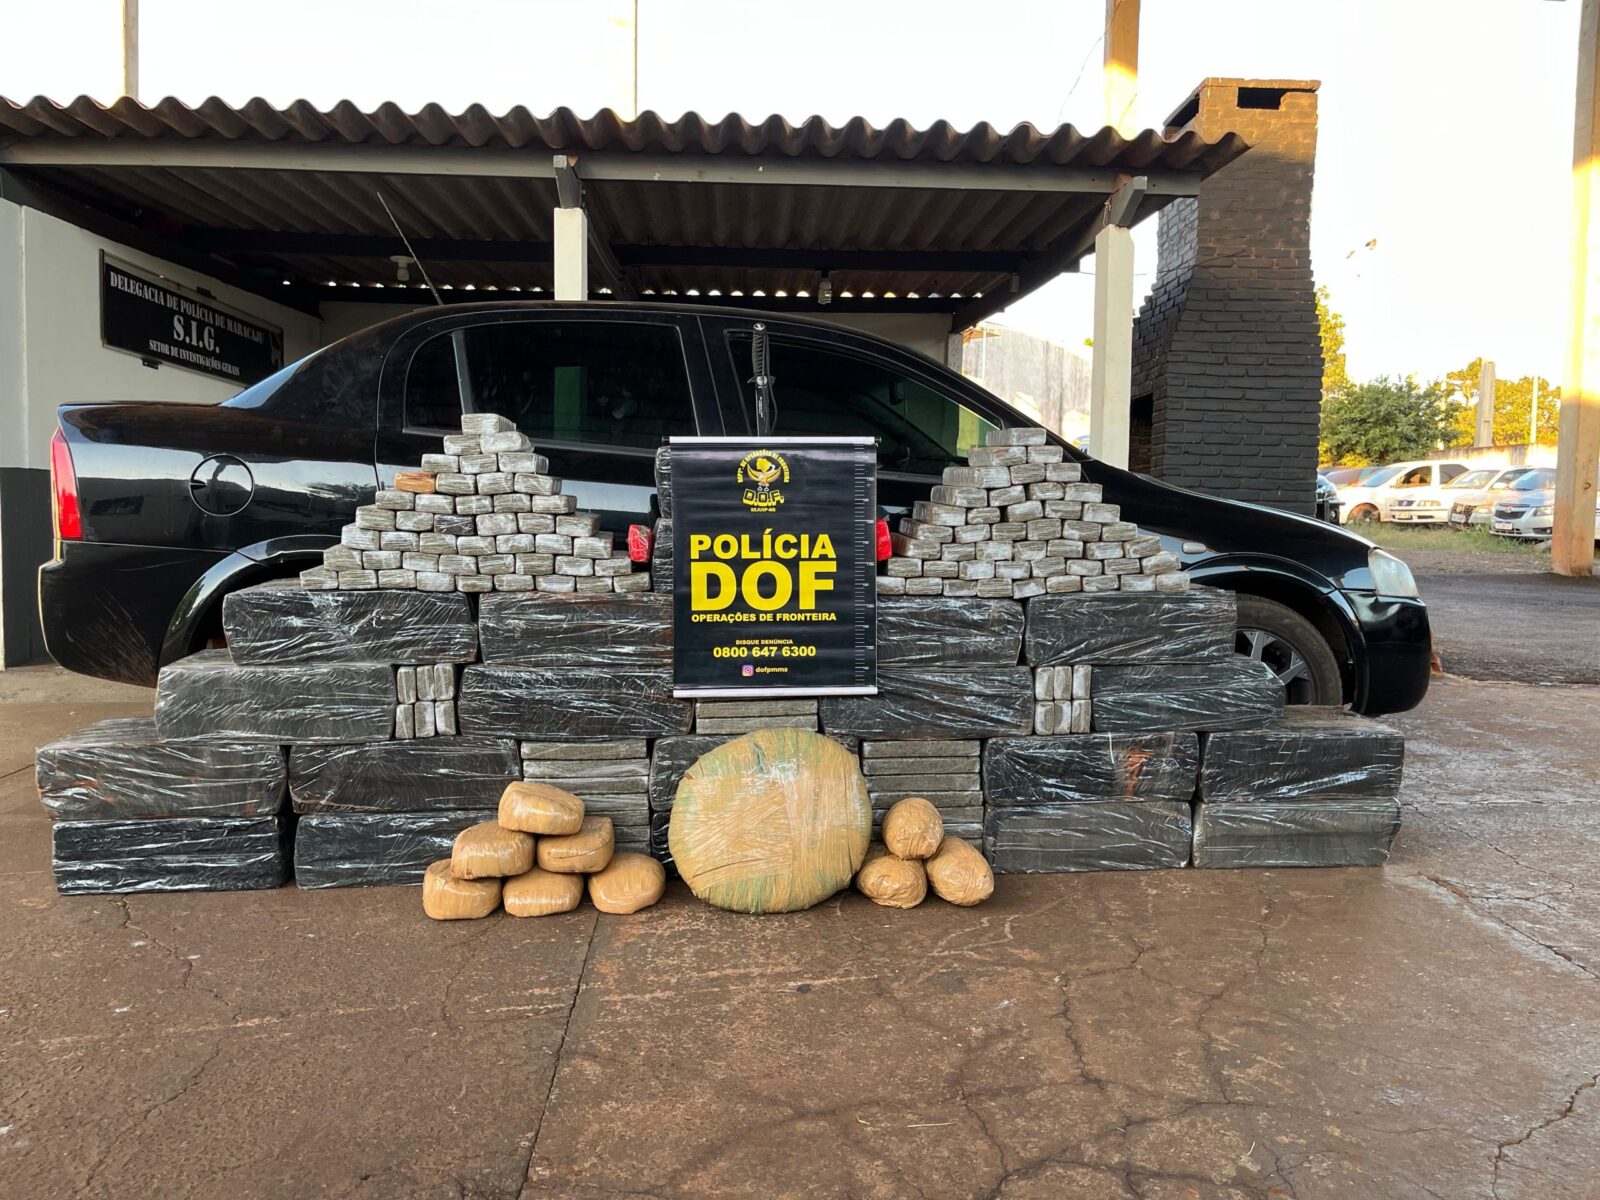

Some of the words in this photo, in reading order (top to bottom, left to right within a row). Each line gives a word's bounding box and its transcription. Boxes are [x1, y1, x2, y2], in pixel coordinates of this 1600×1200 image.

[110, 271, 165, 306] DELEGACIA
[166, 293, 179, 311] DE
[215, 313, 226, 329] DE
[173, 314, 220, 354] S.I.G.
[149, 340, 170, 355] SETOR
[170, 345, 179, 358] DE
[690, 528, 837, 559] POLÍCIA
[690, 560, 837, 611] DOF
[691, 612, 757, 623] OPERAÇÕES
[759, 613, 774, 622] DE
[776, 612, 837, 622] FRONTEIRA
[712, 646, 748, 658] 0800
[751, 646, 778, 657] 647
[781, 645, 817, 657] 6300
[755, 666, 789, 674] dofpmms
